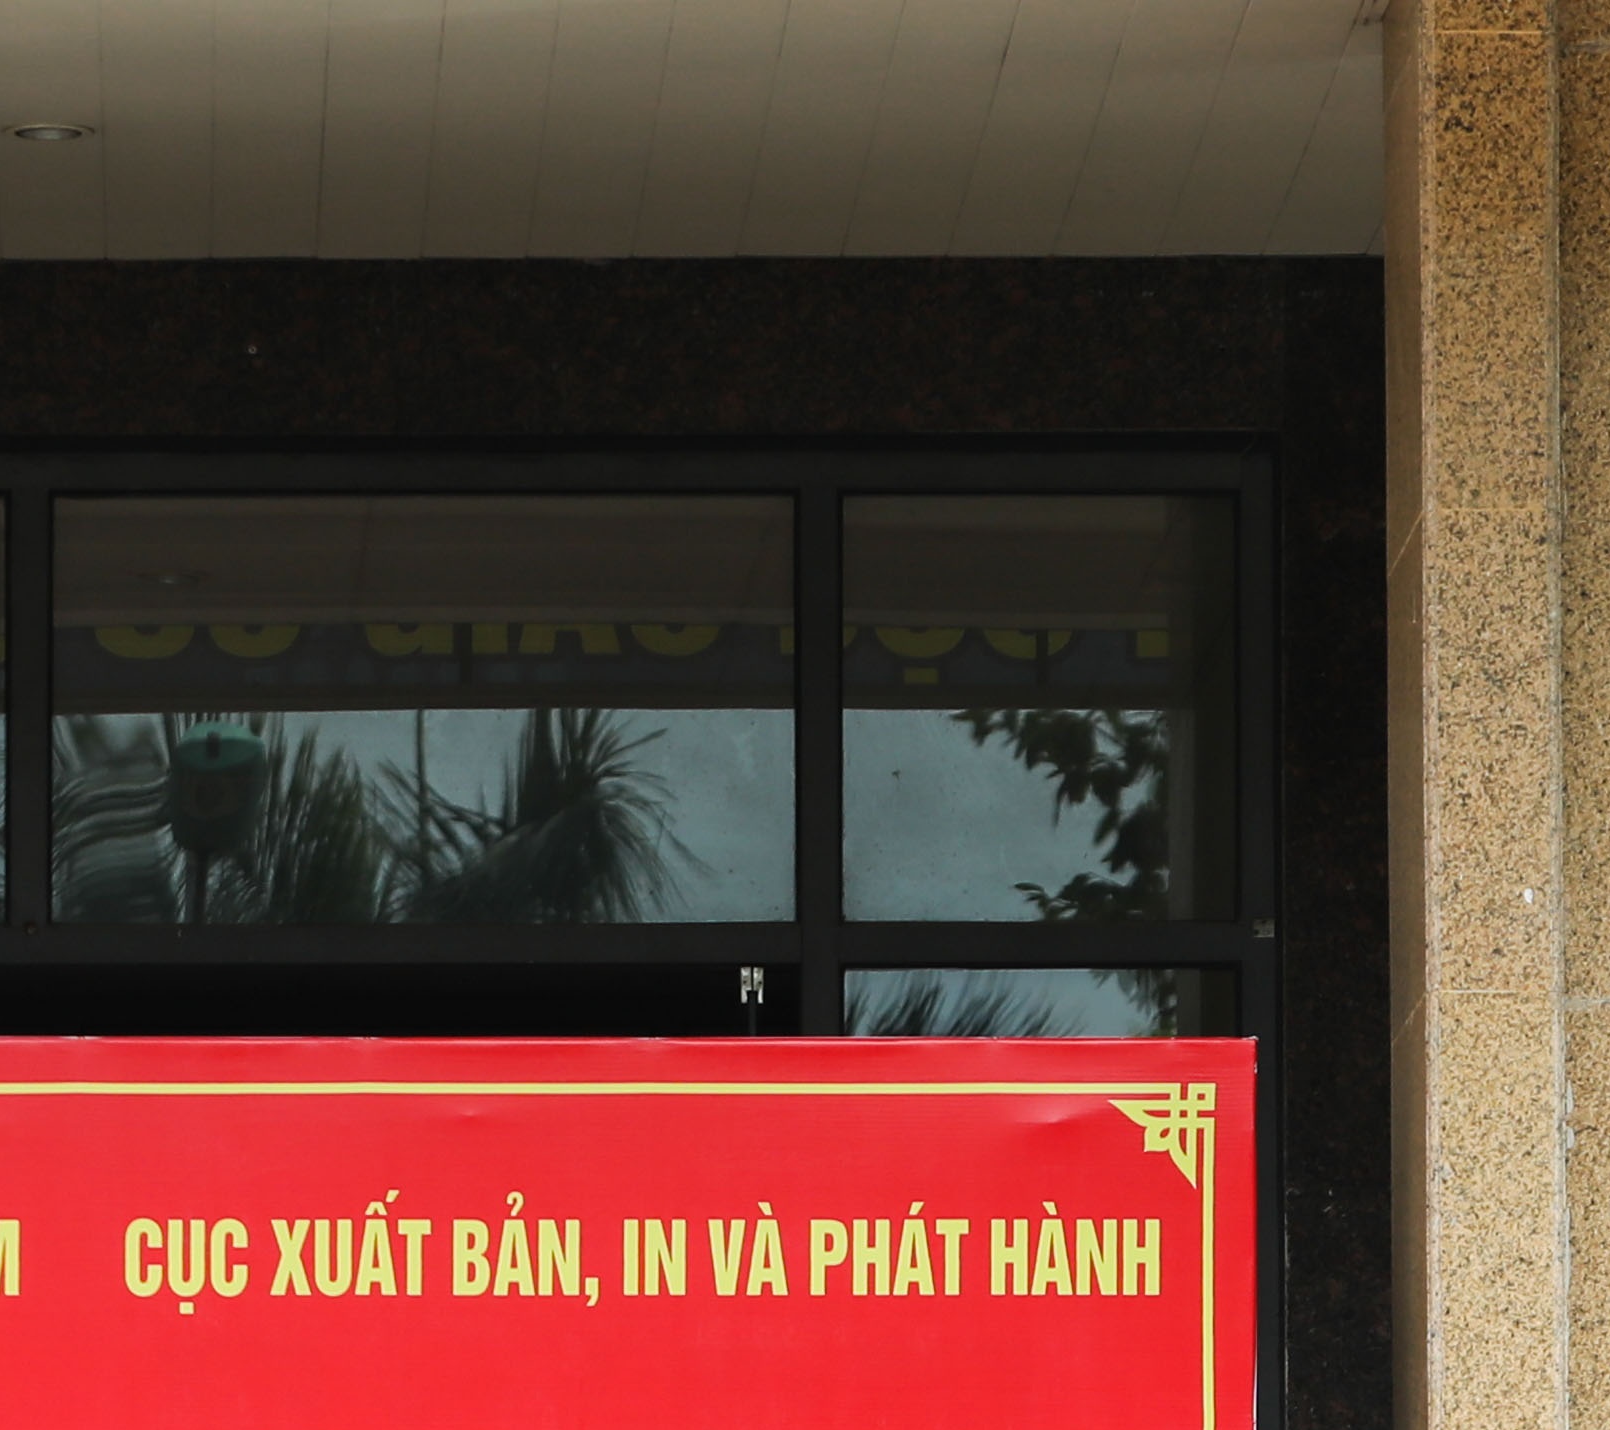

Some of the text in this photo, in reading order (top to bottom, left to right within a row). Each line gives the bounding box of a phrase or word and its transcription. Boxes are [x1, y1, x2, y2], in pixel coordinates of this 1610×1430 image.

[125, 1190, 1161, 1314] CỤC XUẤT BẢN, IN VÀ PHÁT HÀNH
